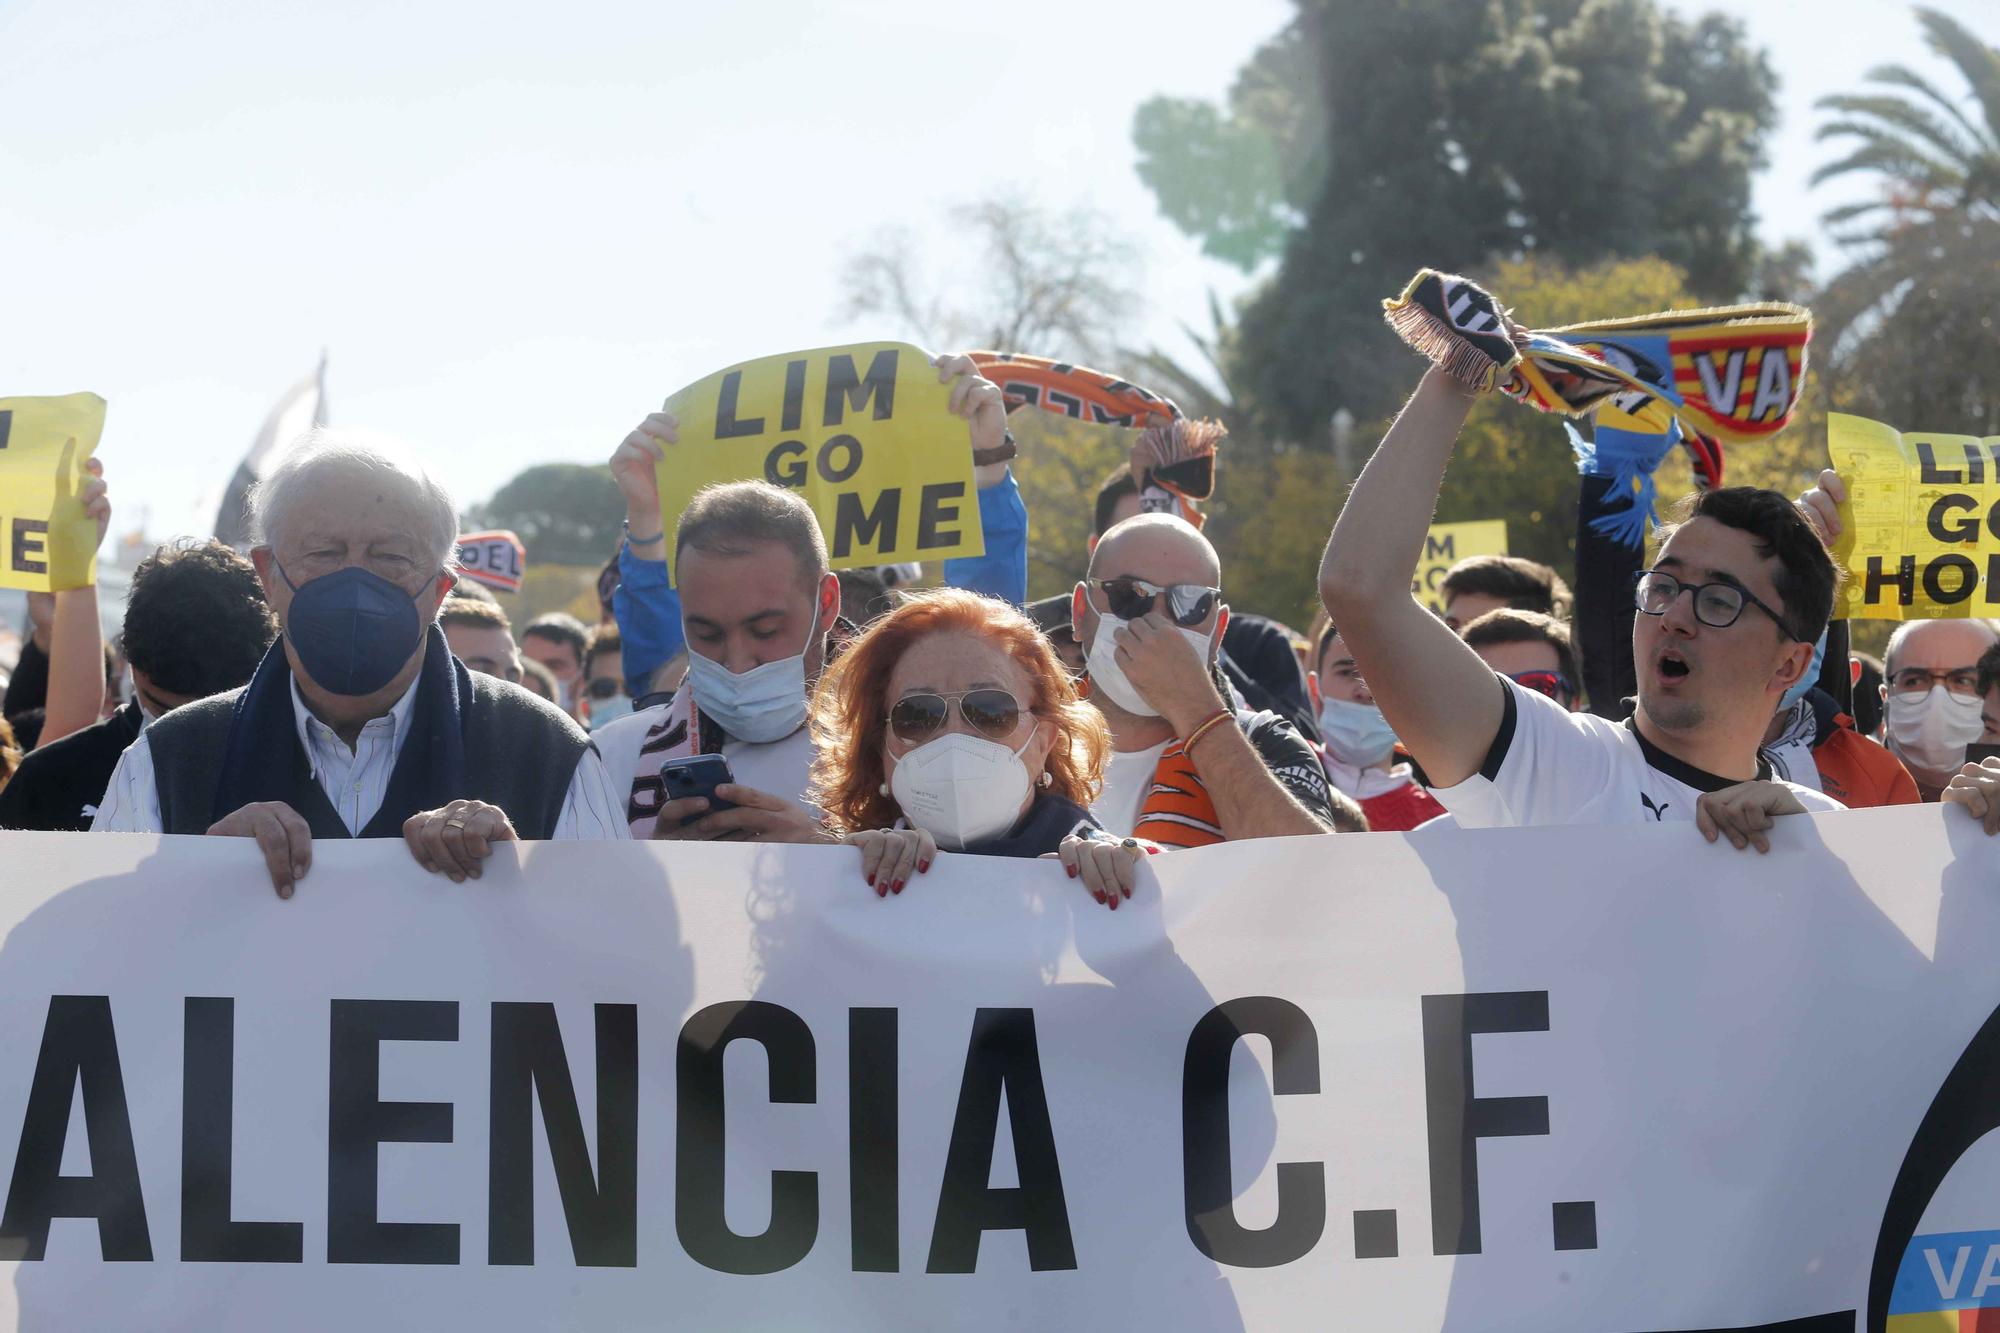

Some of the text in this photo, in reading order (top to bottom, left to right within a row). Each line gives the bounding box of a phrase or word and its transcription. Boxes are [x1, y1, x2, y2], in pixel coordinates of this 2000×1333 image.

[714, 349, 899, 440] LIM
[764, 434, 863, 488] GO
[1915, 443, 2000, 484] LI
[1927, 493, 2000, 543] G
[1864, 553, 2000, 606] HO
[0, 990, 1598, 1275] ALENCIA C.F.
